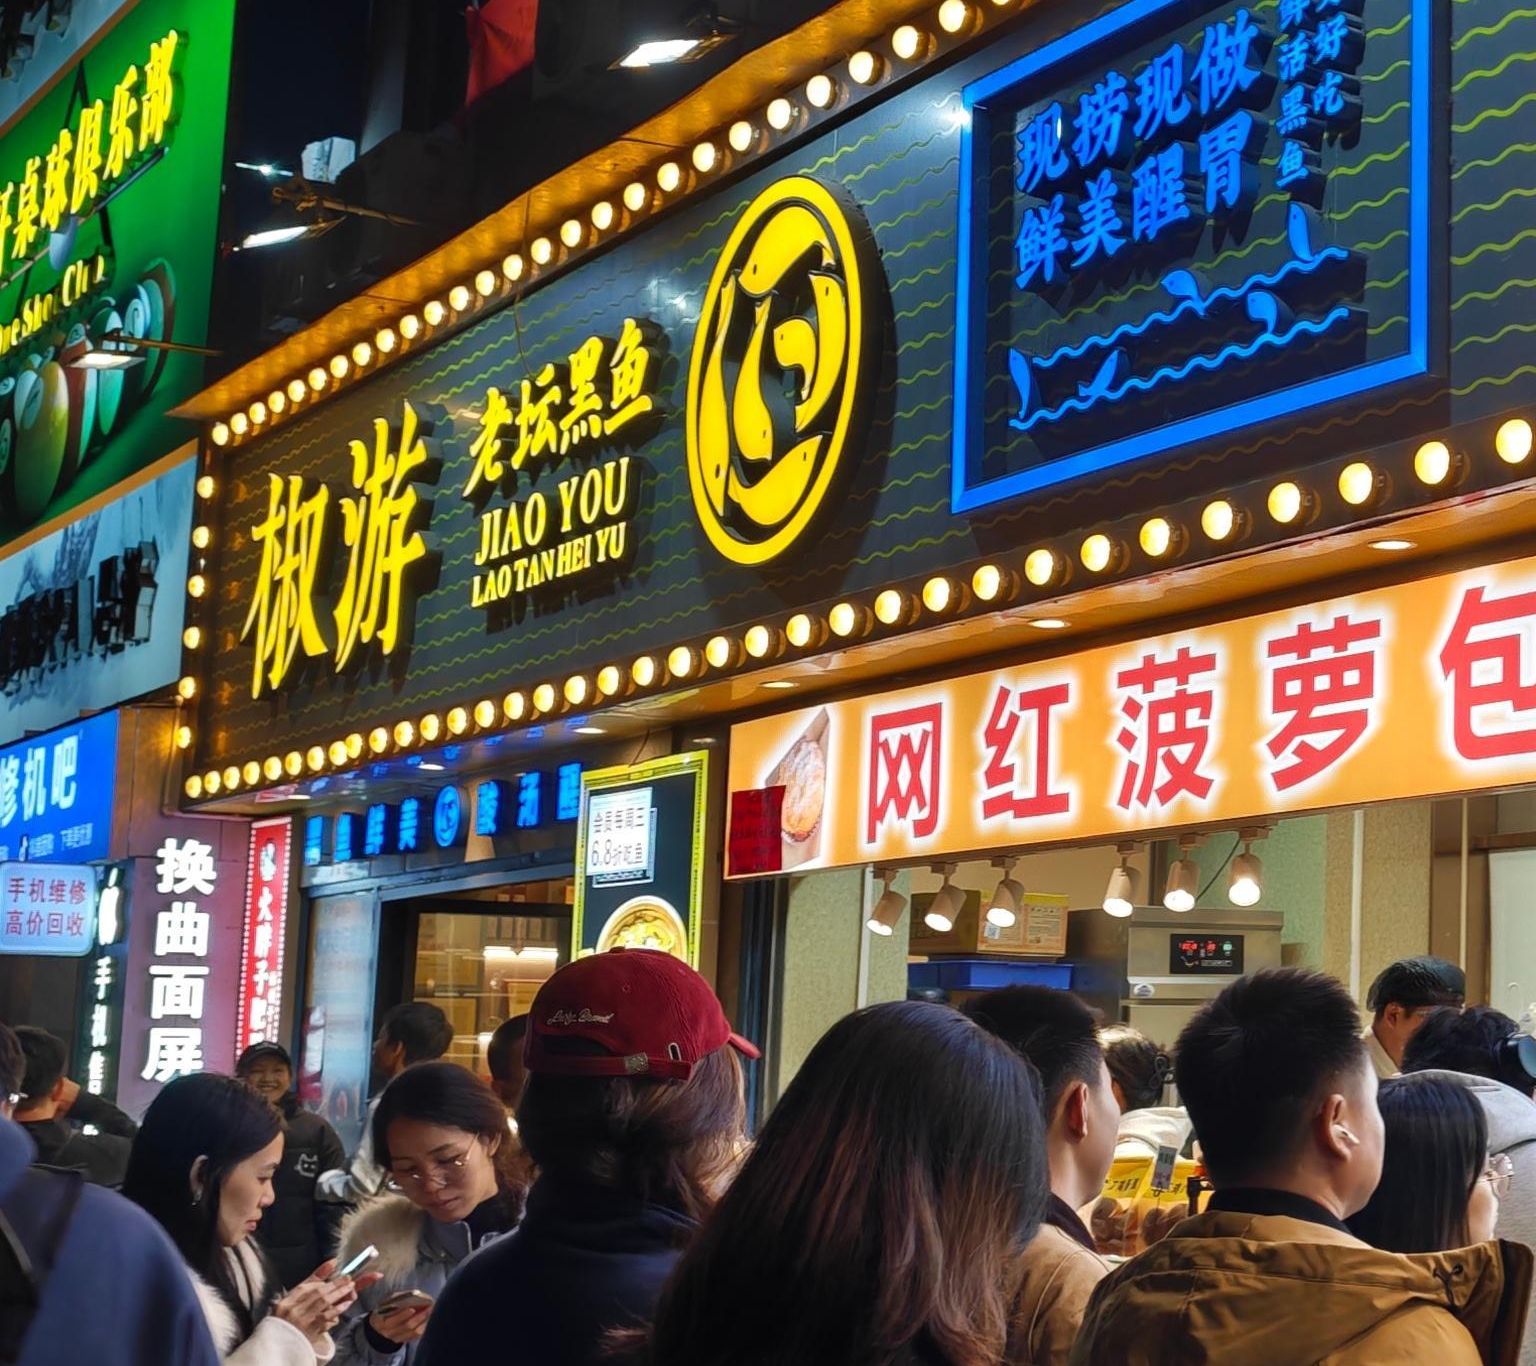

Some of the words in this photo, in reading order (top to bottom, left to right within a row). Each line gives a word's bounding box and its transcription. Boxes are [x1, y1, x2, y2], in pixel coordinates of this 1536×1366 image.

[1015, 6, 1262, 194] 现捞现做
[1013, 111, 1258, 291] 鲜美醒胃
[462, 317, 652, 499] 老坛黑鱼
[241, 398, 427, 700] 椒游
[474, 490, 546, 568] JIAO
[559, 457, 631, 531] YOU
[5, 909, 85, 937] 高价回收
[8, 878, 88, 905] 手机维修
[139, 836, 218, 1083] 换曲面屏
